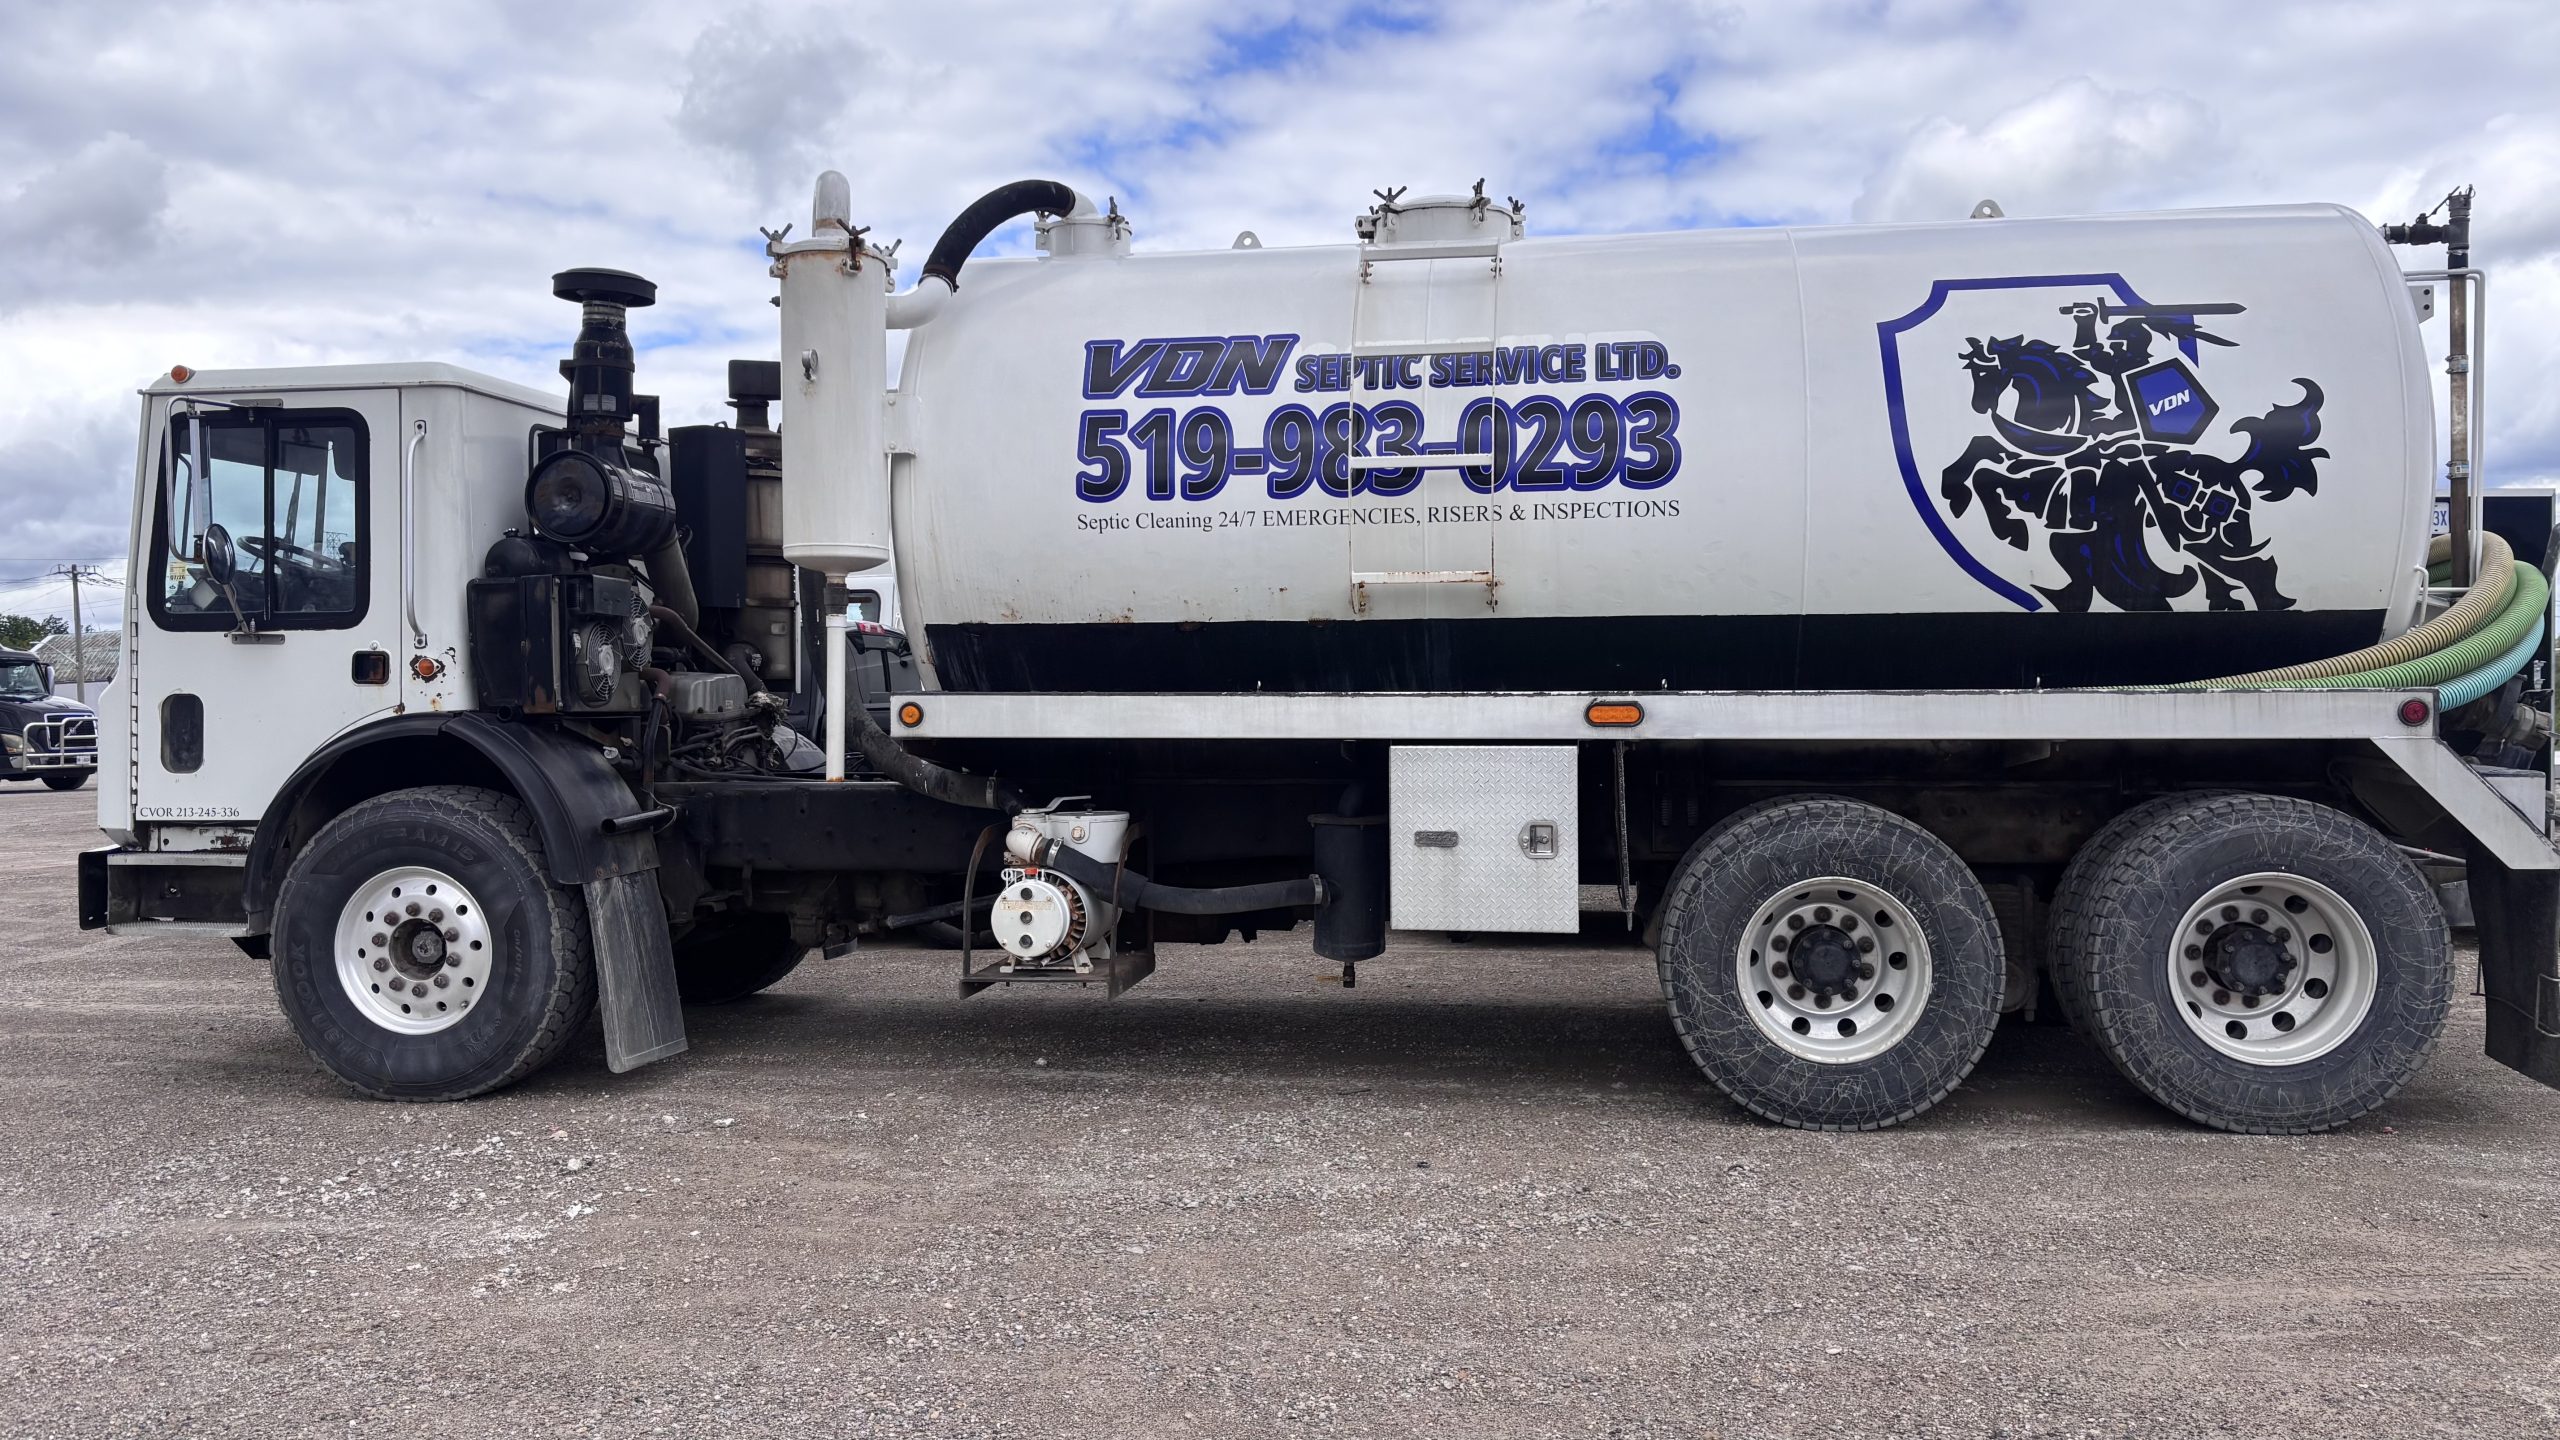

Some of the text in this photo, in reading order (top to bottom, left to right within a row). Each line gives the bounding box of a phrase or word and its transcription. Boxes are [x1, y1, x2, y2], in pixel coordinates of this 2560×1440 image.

[1083, 334, 1681, 399] VDN SEPTIC SERVICE LTD.
[2149, 389, 2190, 416] VDN
[1076, 390, 1682, 502] 519-983-0293
[1077, 499, 1680, 533] Septic Cleaning 24/7 EMERGENCIES, RISERS & INSPECTIONS
[140, 806, 240, 818] CVOR 213-245-336
